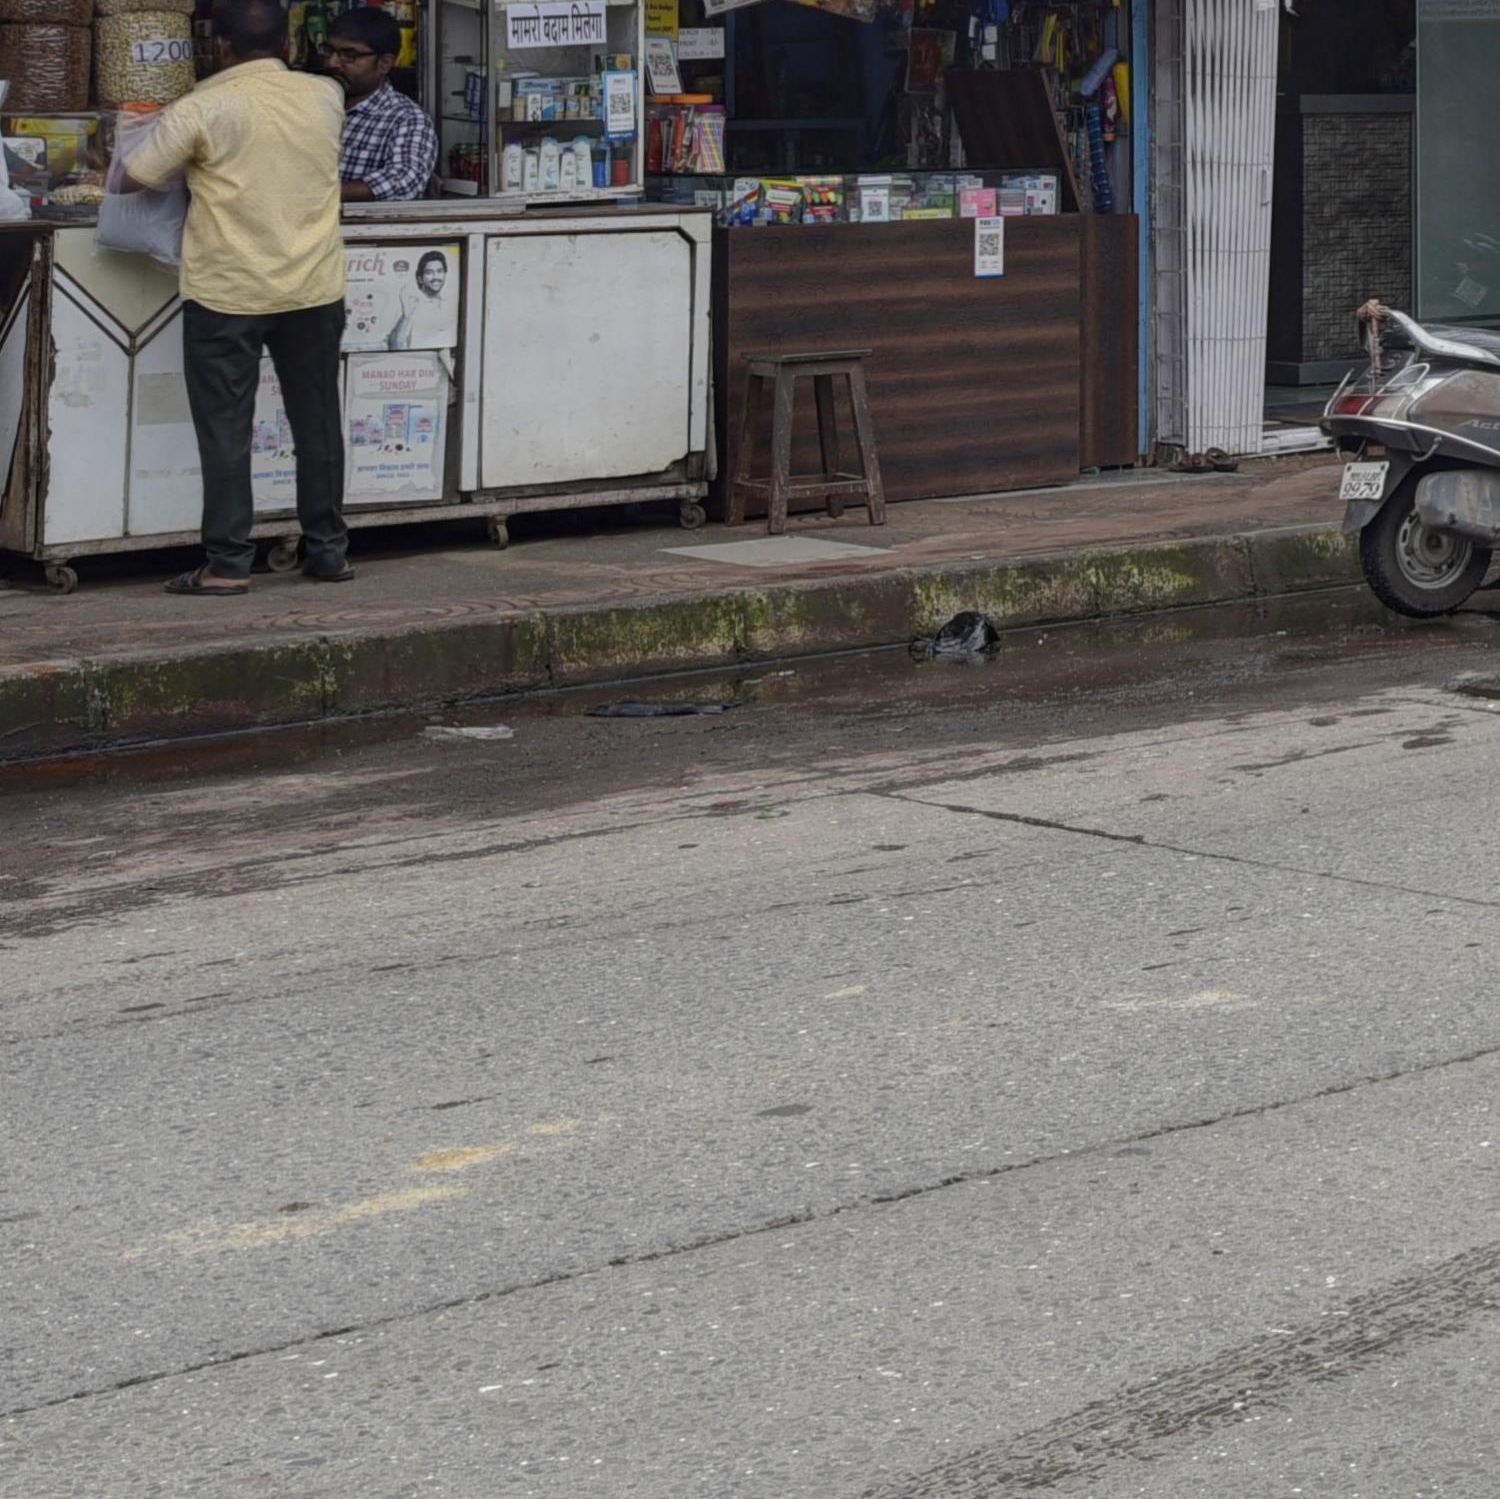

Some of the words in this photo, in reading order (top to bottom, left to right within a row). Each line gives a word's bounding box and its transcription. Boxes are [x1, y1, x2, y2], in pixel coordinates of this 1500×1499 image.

[570, 7, 603, 42] मिलेगा
[134, 40, 192, 63] 1200
[398, 369, 417, 379] HAR
[418, 368, 435, 379] DIN
[379, 380, 417, 391] SUNDAY
